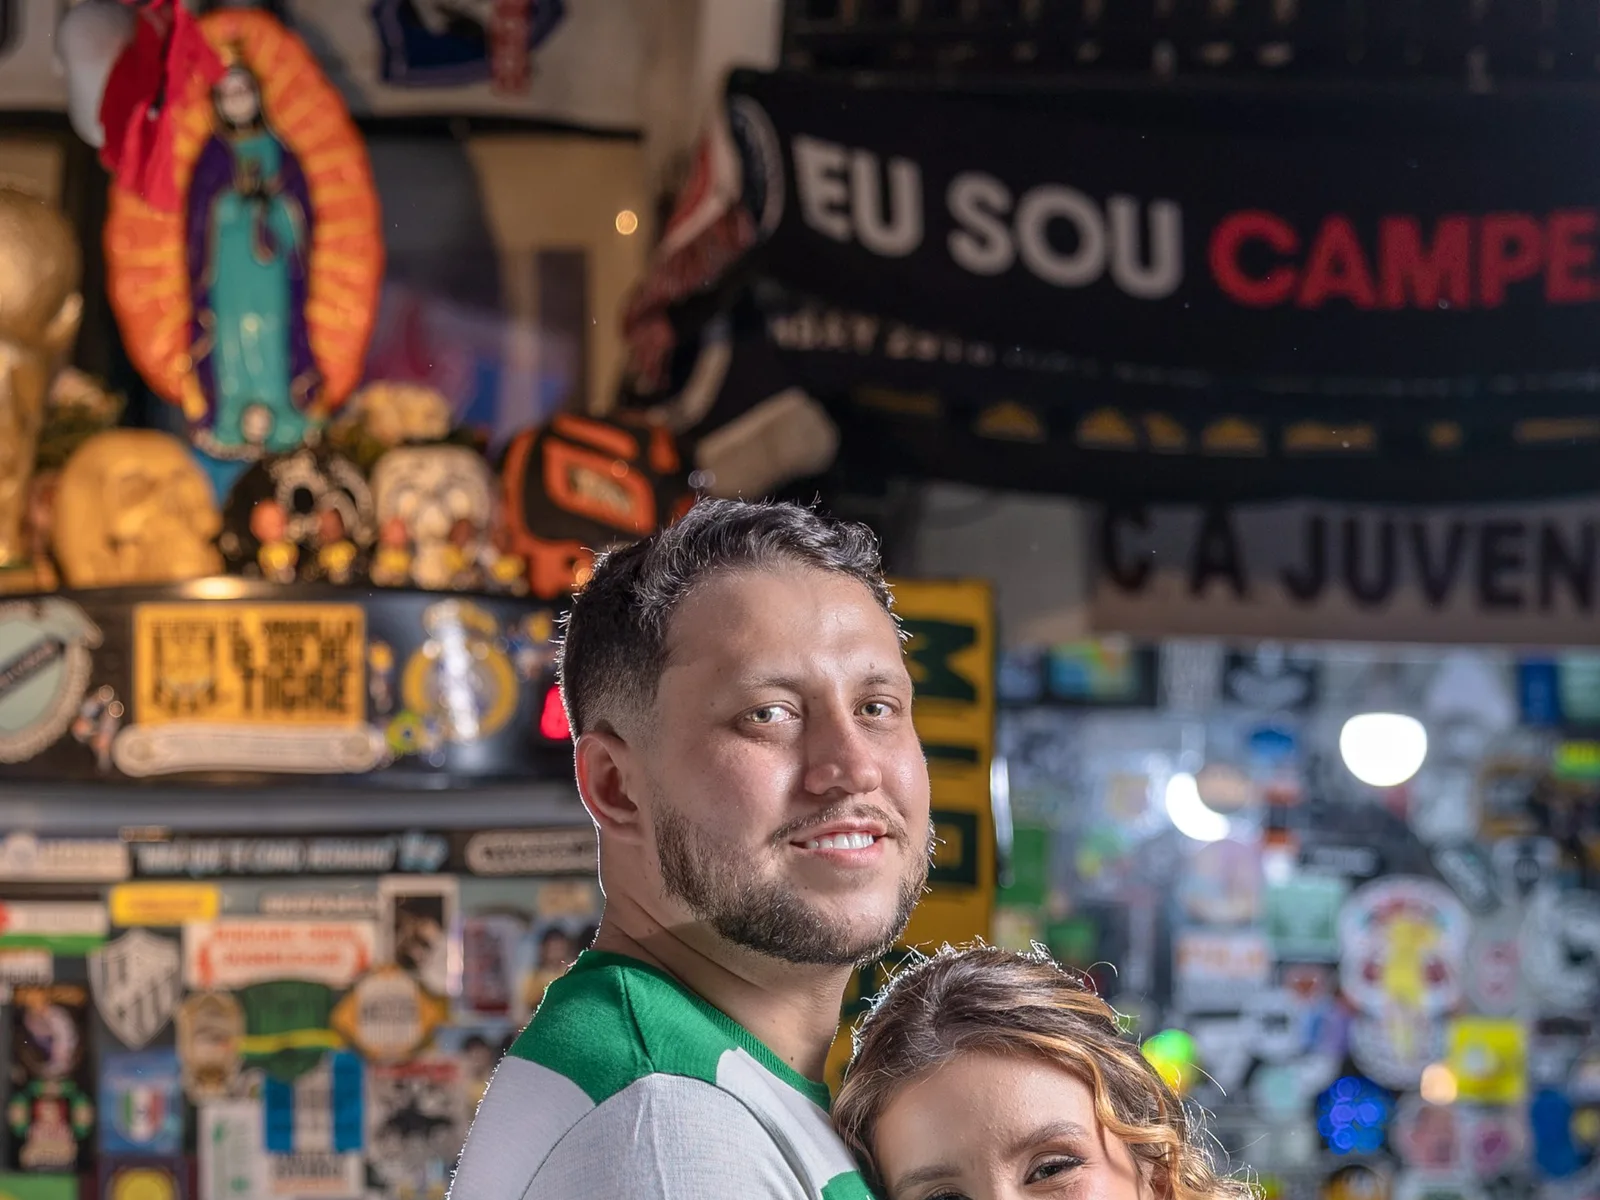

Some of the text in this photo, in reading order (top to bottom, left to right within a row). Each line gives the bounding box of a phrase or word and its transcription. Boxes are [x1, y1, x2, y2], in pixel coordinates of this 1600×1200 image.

[793, 134, 1597, 308] EU SOU CAMPE
[1194, 500, 1245, 595] A
[1282, 515, 1600, 613] JUVEN
